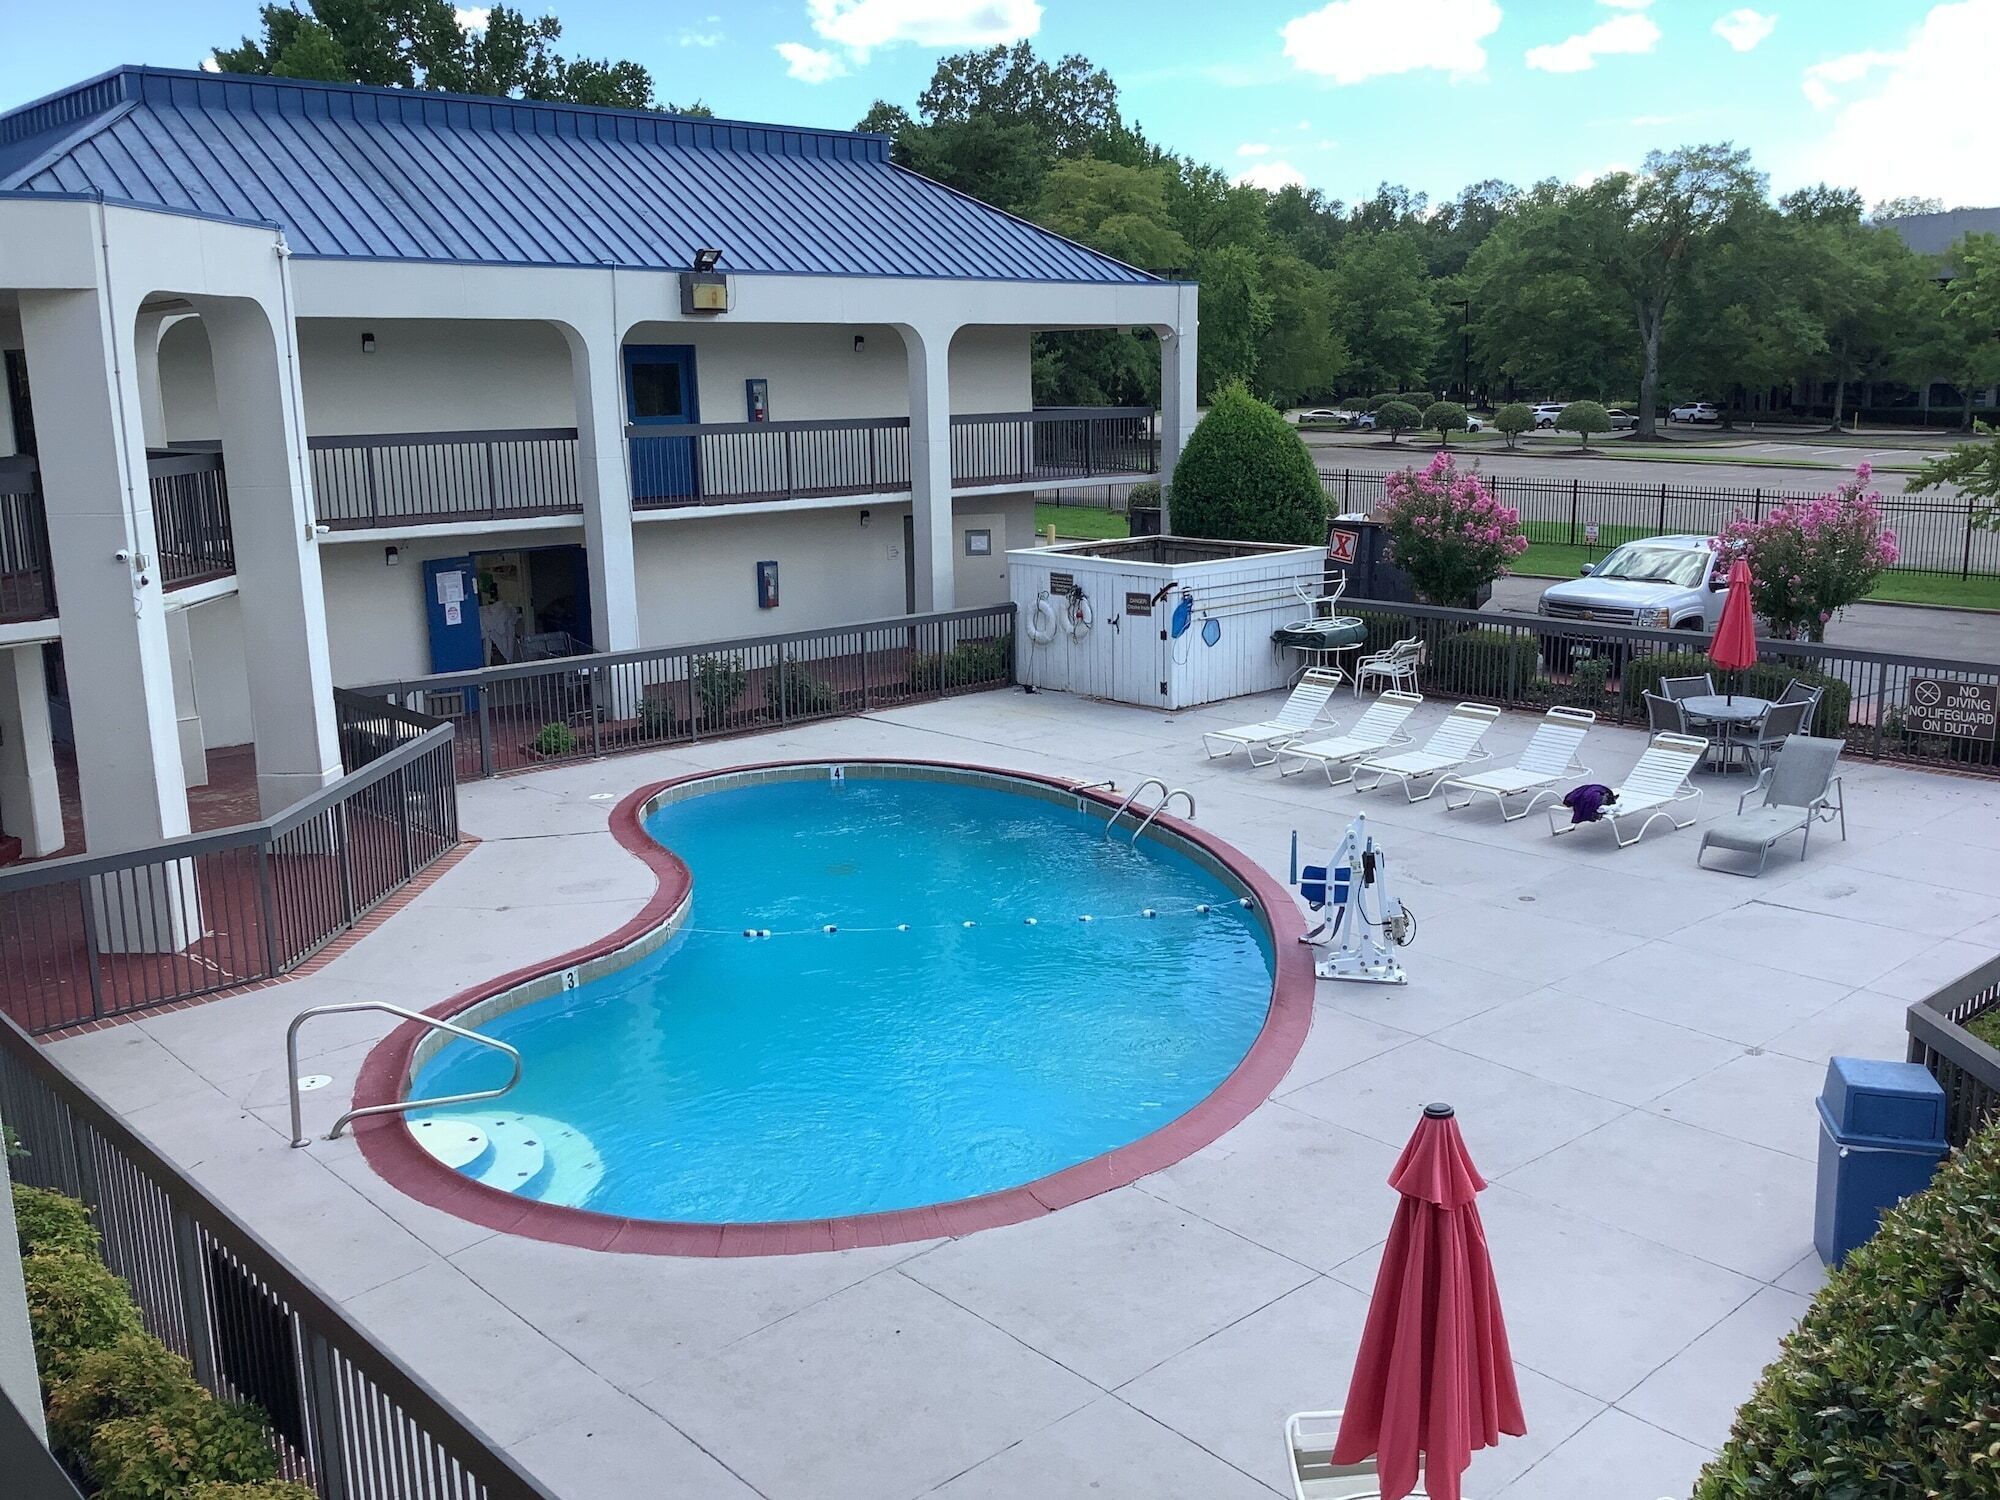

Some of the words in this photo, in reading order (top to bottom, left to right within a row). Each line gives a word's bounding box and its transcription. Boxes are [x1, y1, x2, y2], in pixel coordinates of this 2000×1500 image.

[1332, 533, 1351, 558] X
[1959, 686, 1980, 698] NO
[1946, 696, 1991, 711] DIVING
[1908, 705, 1927, 717] NO
[1927, 708, 1994, 725] LIFEGUARD
[1922, 720, 1940, 731] ON
[1944, 722, 1977, 735] DUTY
[834, 767, 840, 780] 4
[567, 972, 575, 989] 3
